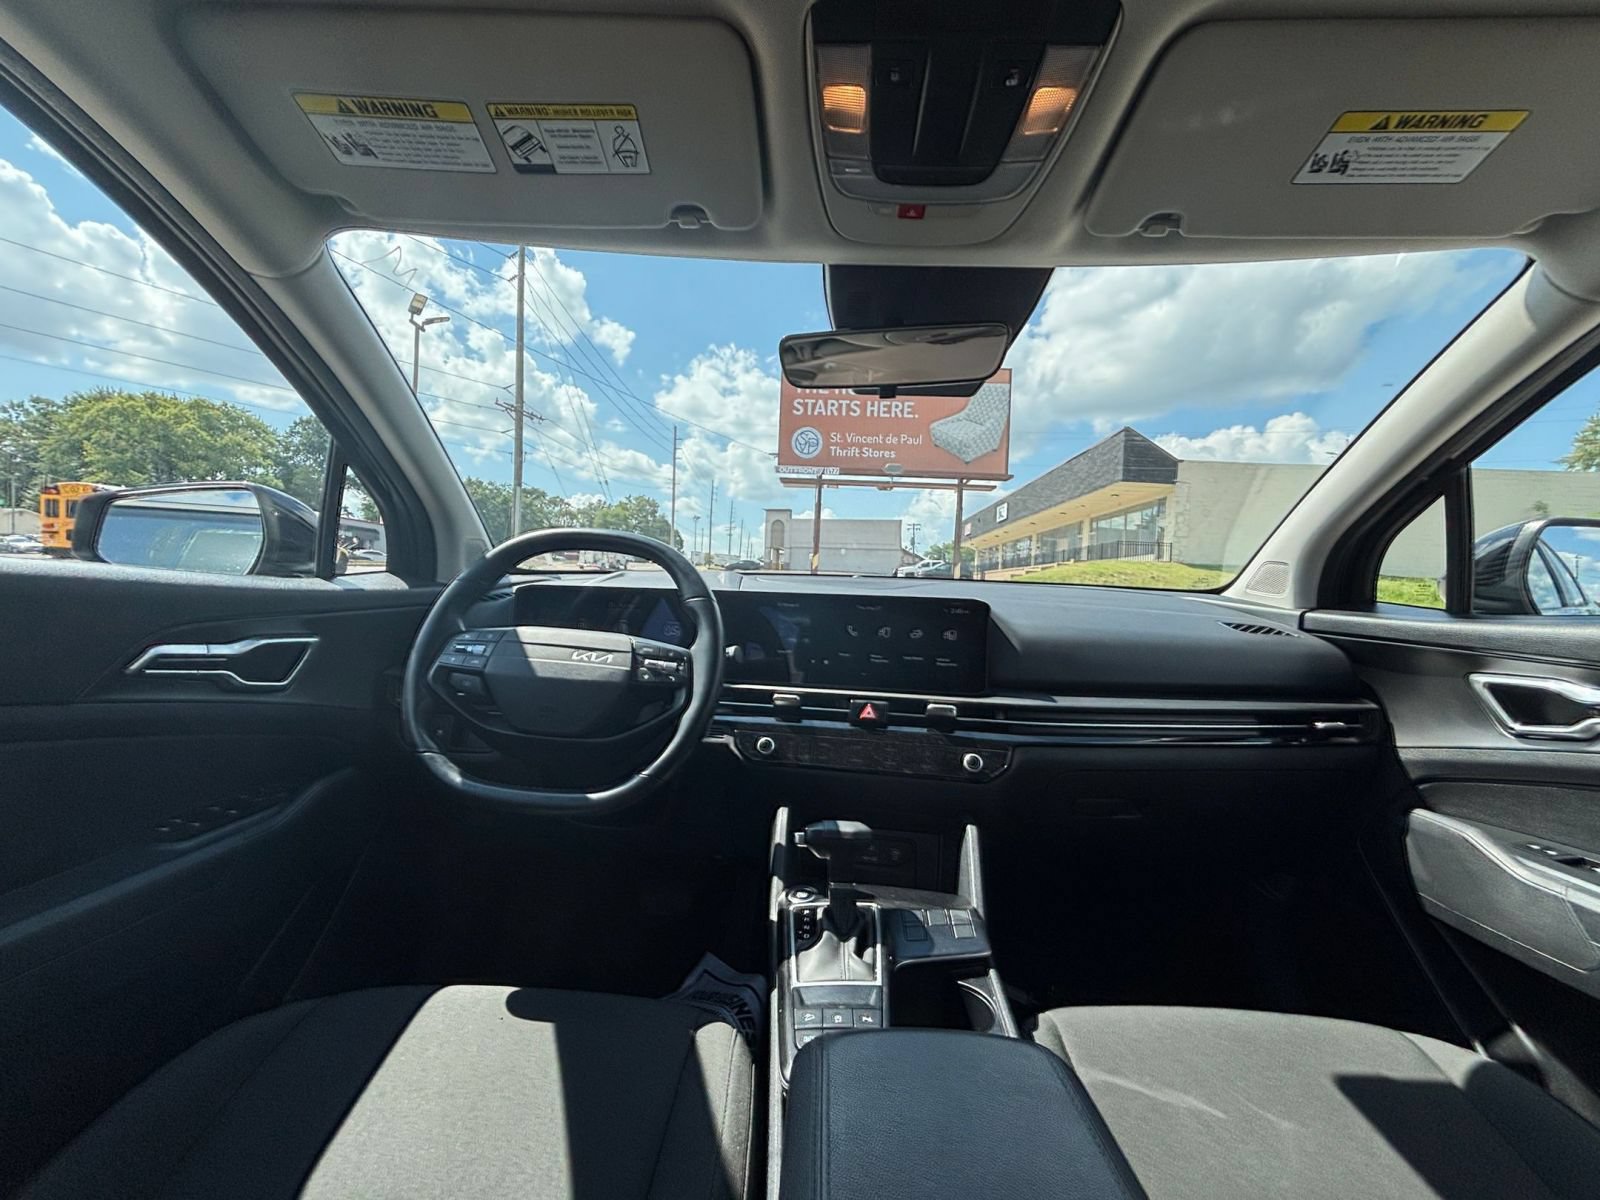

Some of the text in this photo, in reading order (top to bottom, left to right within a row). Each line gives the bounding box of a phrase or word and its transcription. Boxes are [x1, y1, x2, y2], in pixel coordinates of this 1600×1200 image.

[350, 98, 439, 119] WARNING
[1394, 114, 1489, 129] WARNING
[792, 398, 919, 418] STARTS HERE.
[829, 432, 923, 445] St. Vincent de Paul
[829, 446, 896, 458] Thrift Stores
[571, 651, 614, 664] KIA
